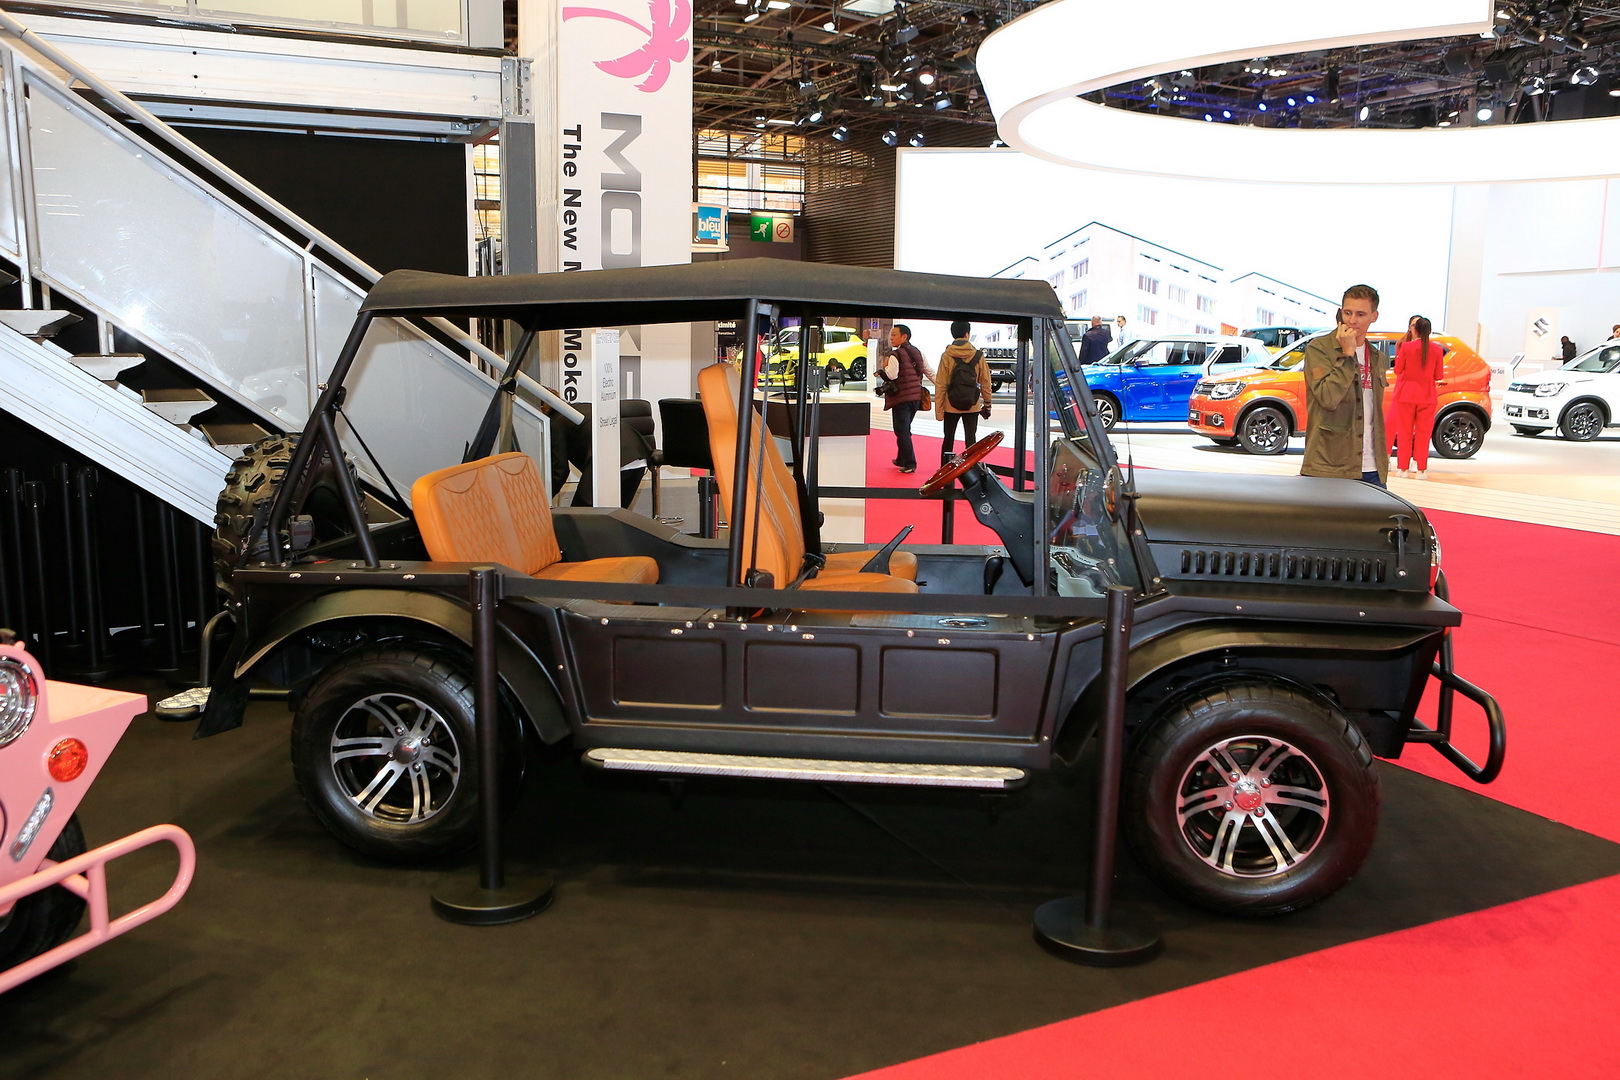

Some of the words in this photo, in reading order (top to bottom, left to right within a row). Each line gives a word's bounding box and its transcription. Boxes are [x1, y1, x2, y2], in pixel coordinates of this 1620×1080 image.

[563, 124, 581, 177] The
[563, 189, 581, 250] New
[698, 218, 720, 232] bleu
[563, 330, 582, 401] Moke
